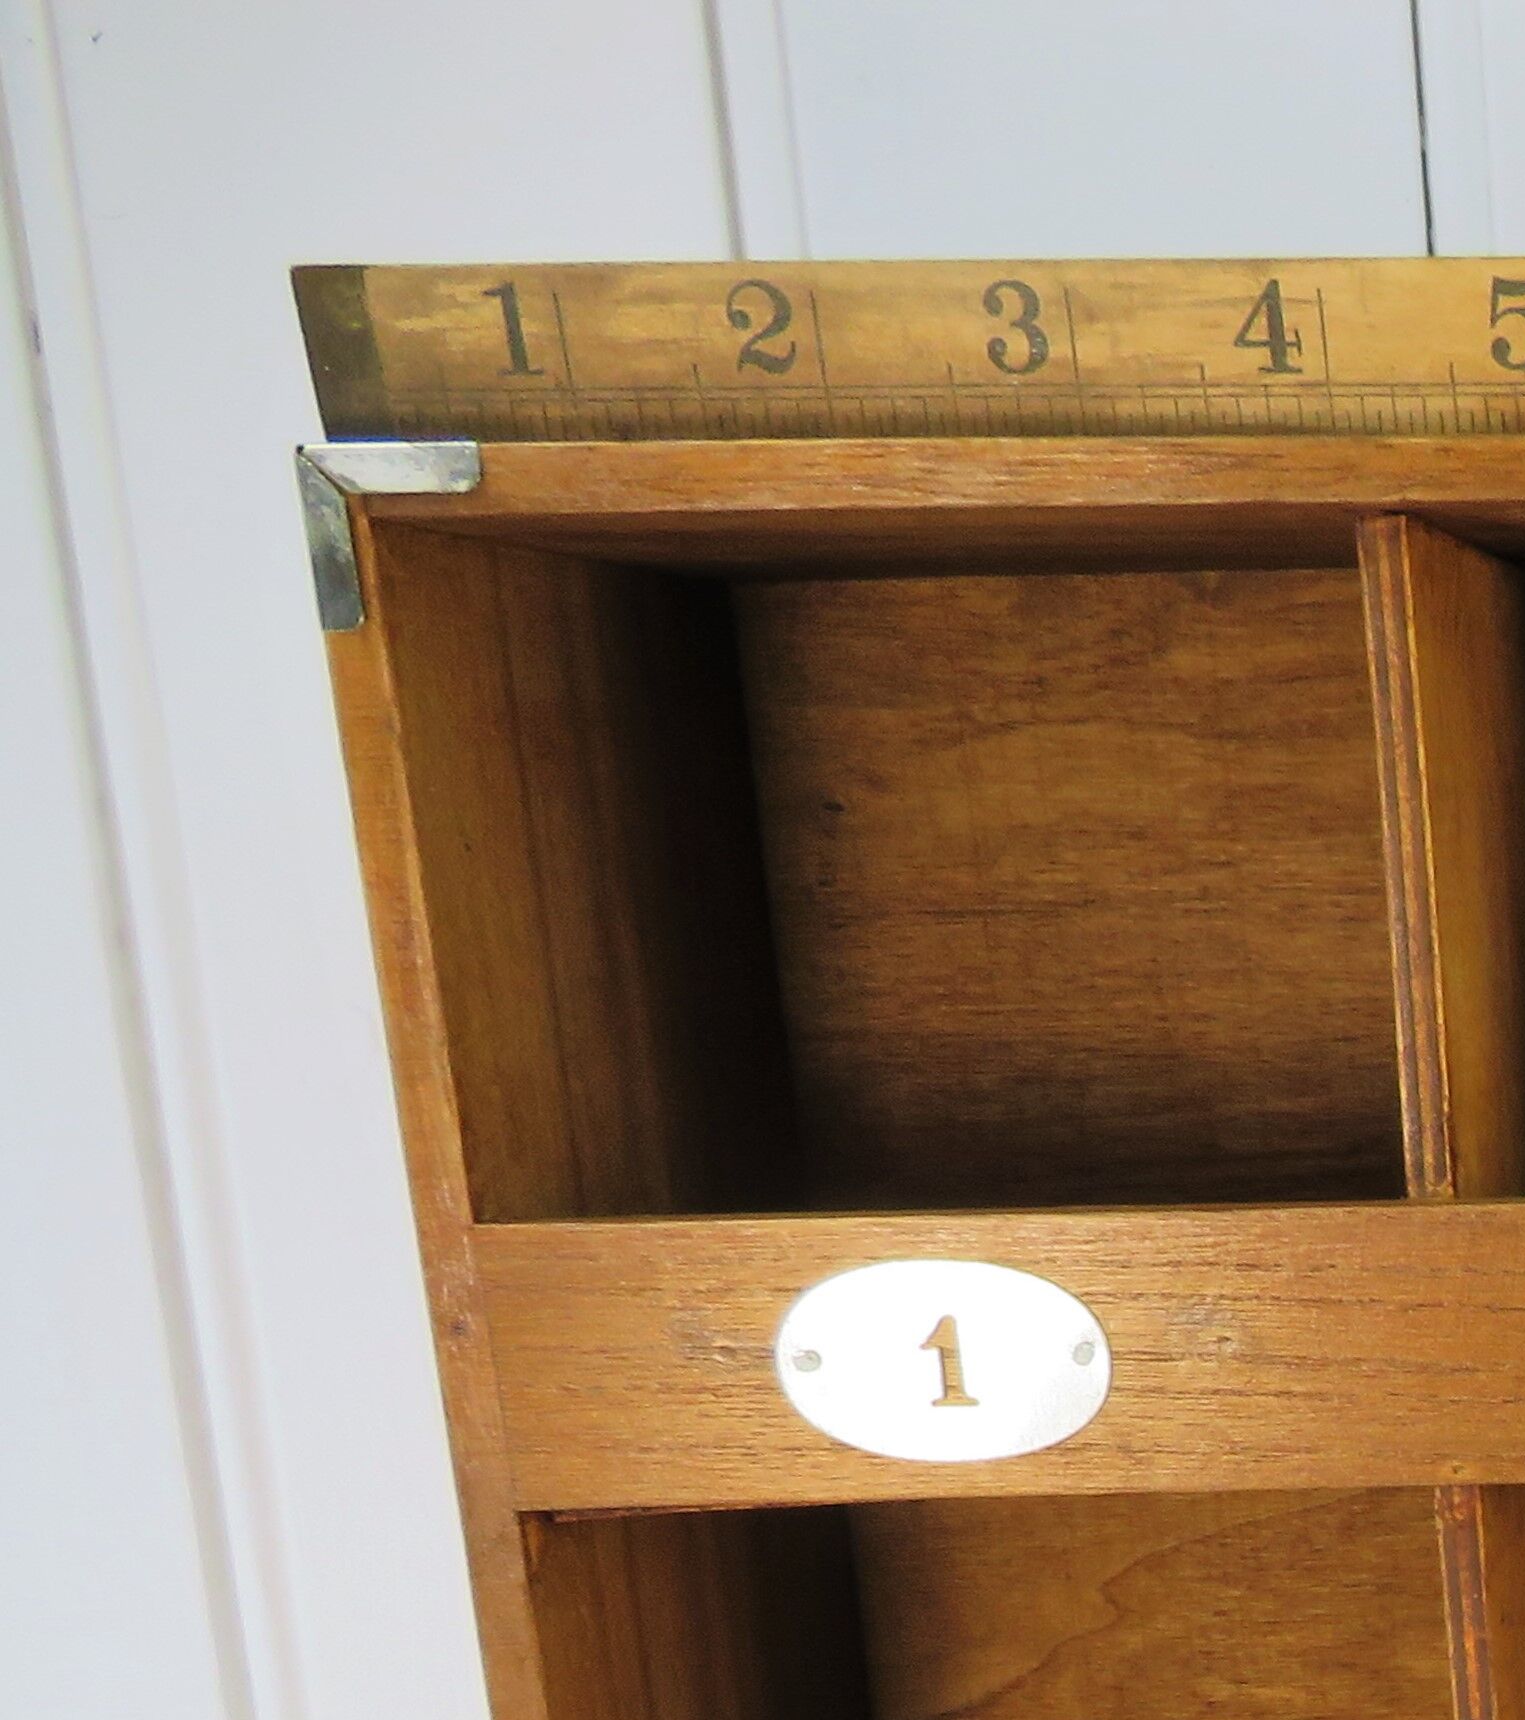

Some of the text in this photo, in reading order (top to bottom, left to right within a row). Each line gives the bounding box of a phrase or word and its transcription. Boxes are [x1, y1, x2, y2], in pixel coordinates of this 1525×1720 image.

[482, 281, 543, 376] 1
[726, 279, 797, 374] 2
[983, 279, 1049, 374] 3
[1233, 279, 1302, 375] 4
[919, 1314, 980, 1407] 1
